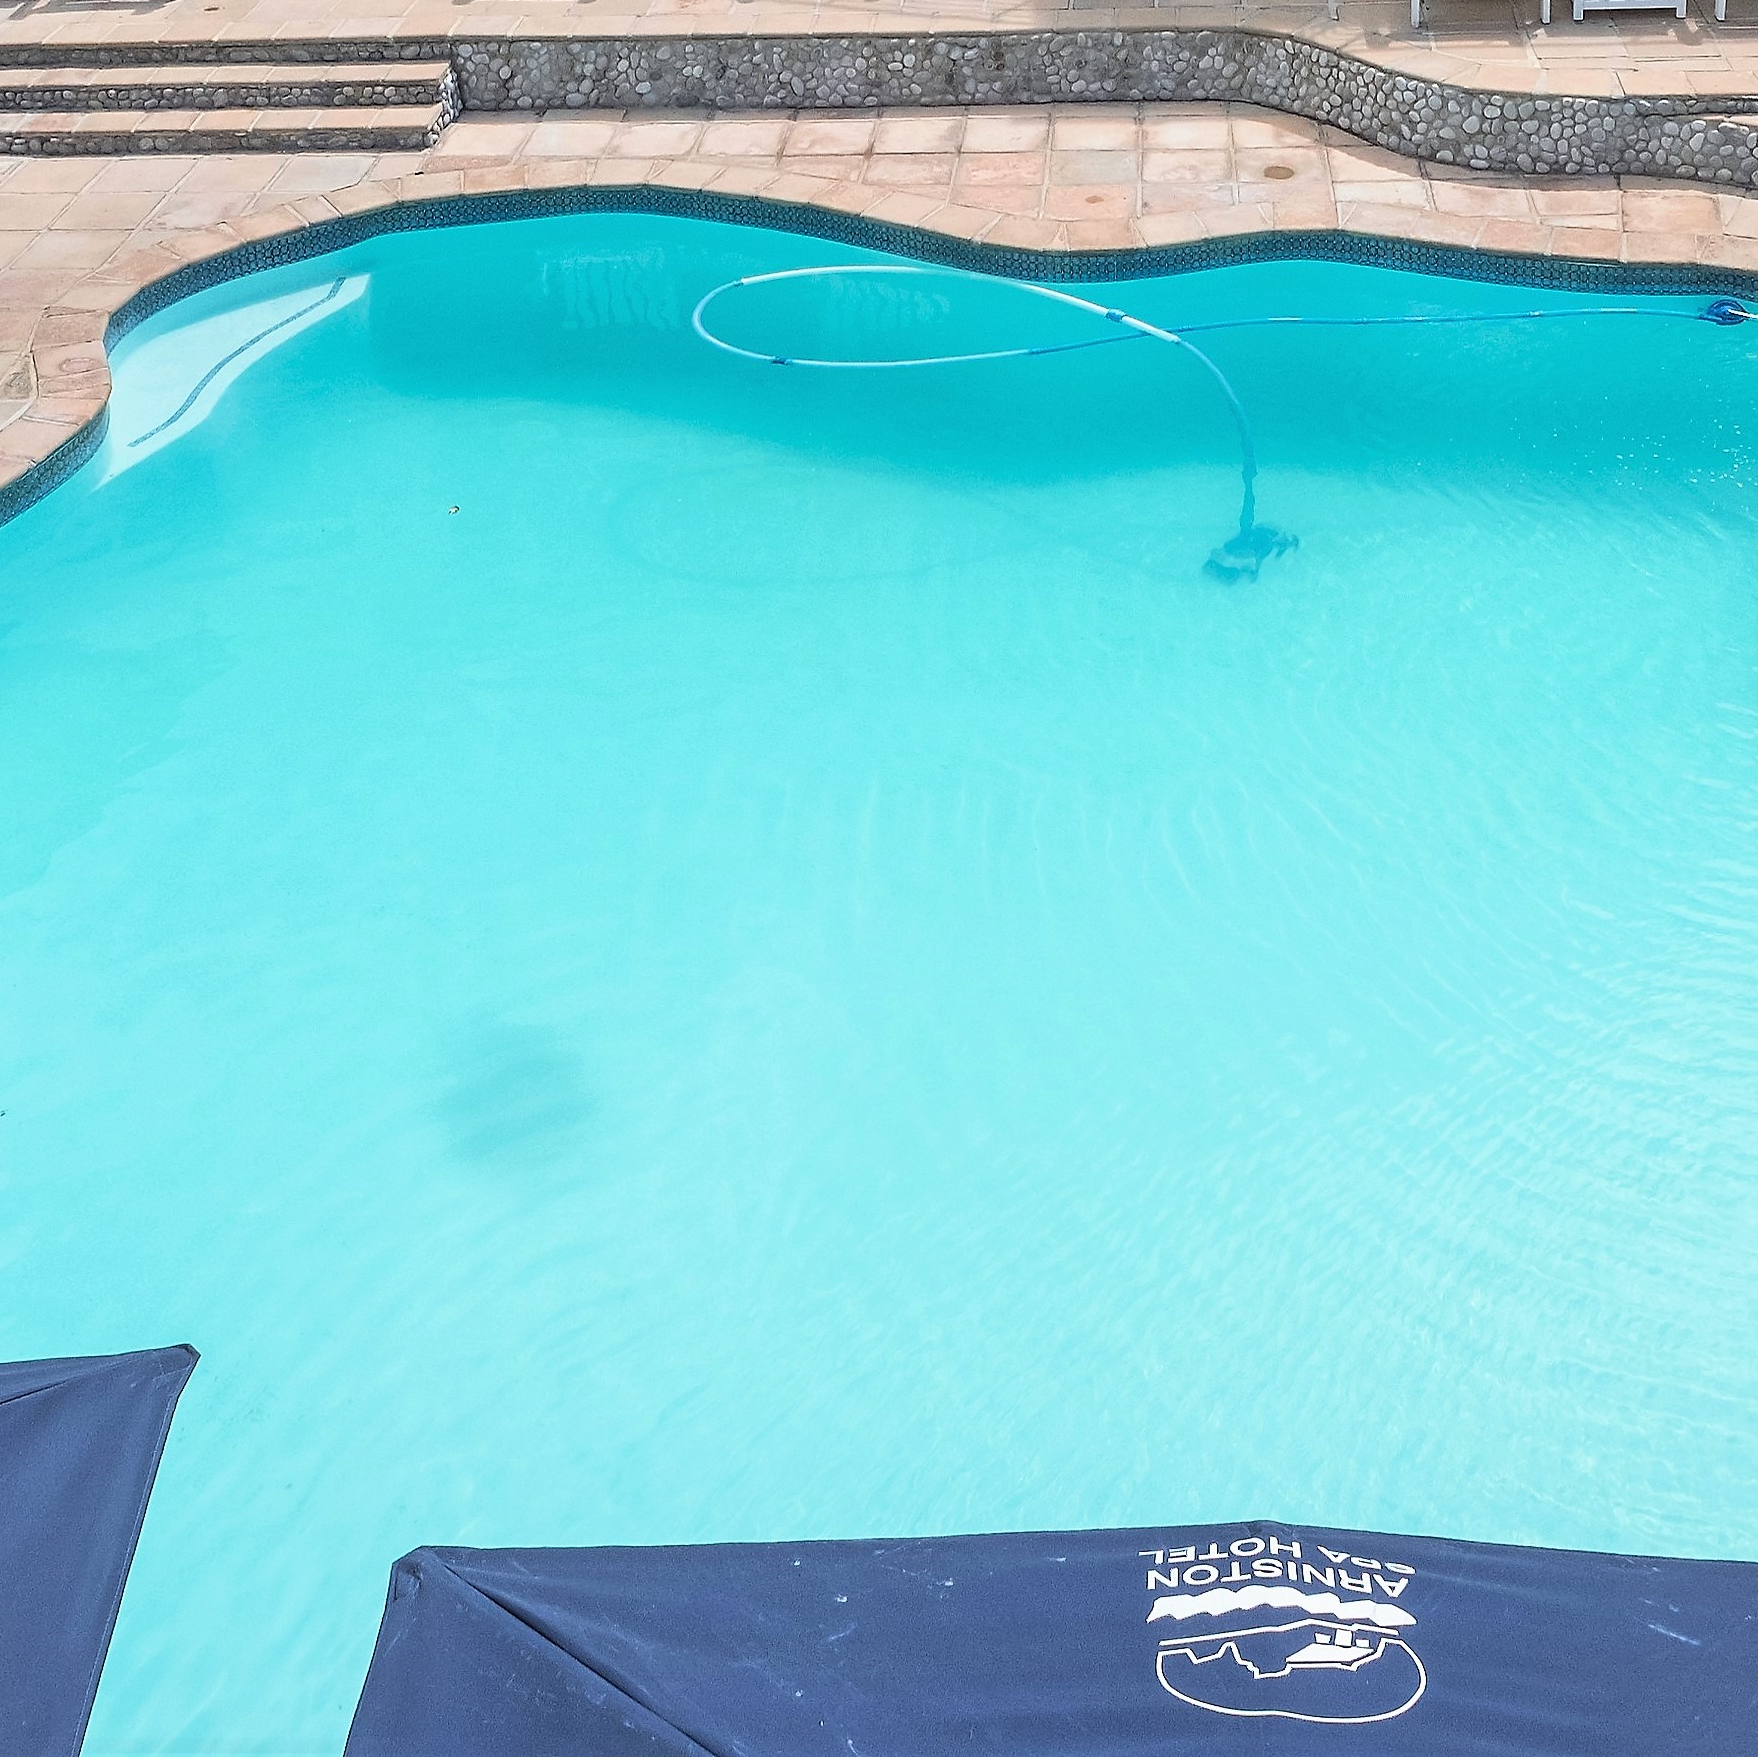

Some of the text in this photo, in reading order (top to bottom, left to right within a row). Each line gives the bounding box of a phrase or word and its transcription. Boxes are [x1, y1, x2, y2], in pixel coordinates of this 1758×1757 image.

[1138, 1535, 1417, 1575] SPA HOTEL
[1146, 1557, 1410, 1598] ARNISTON
